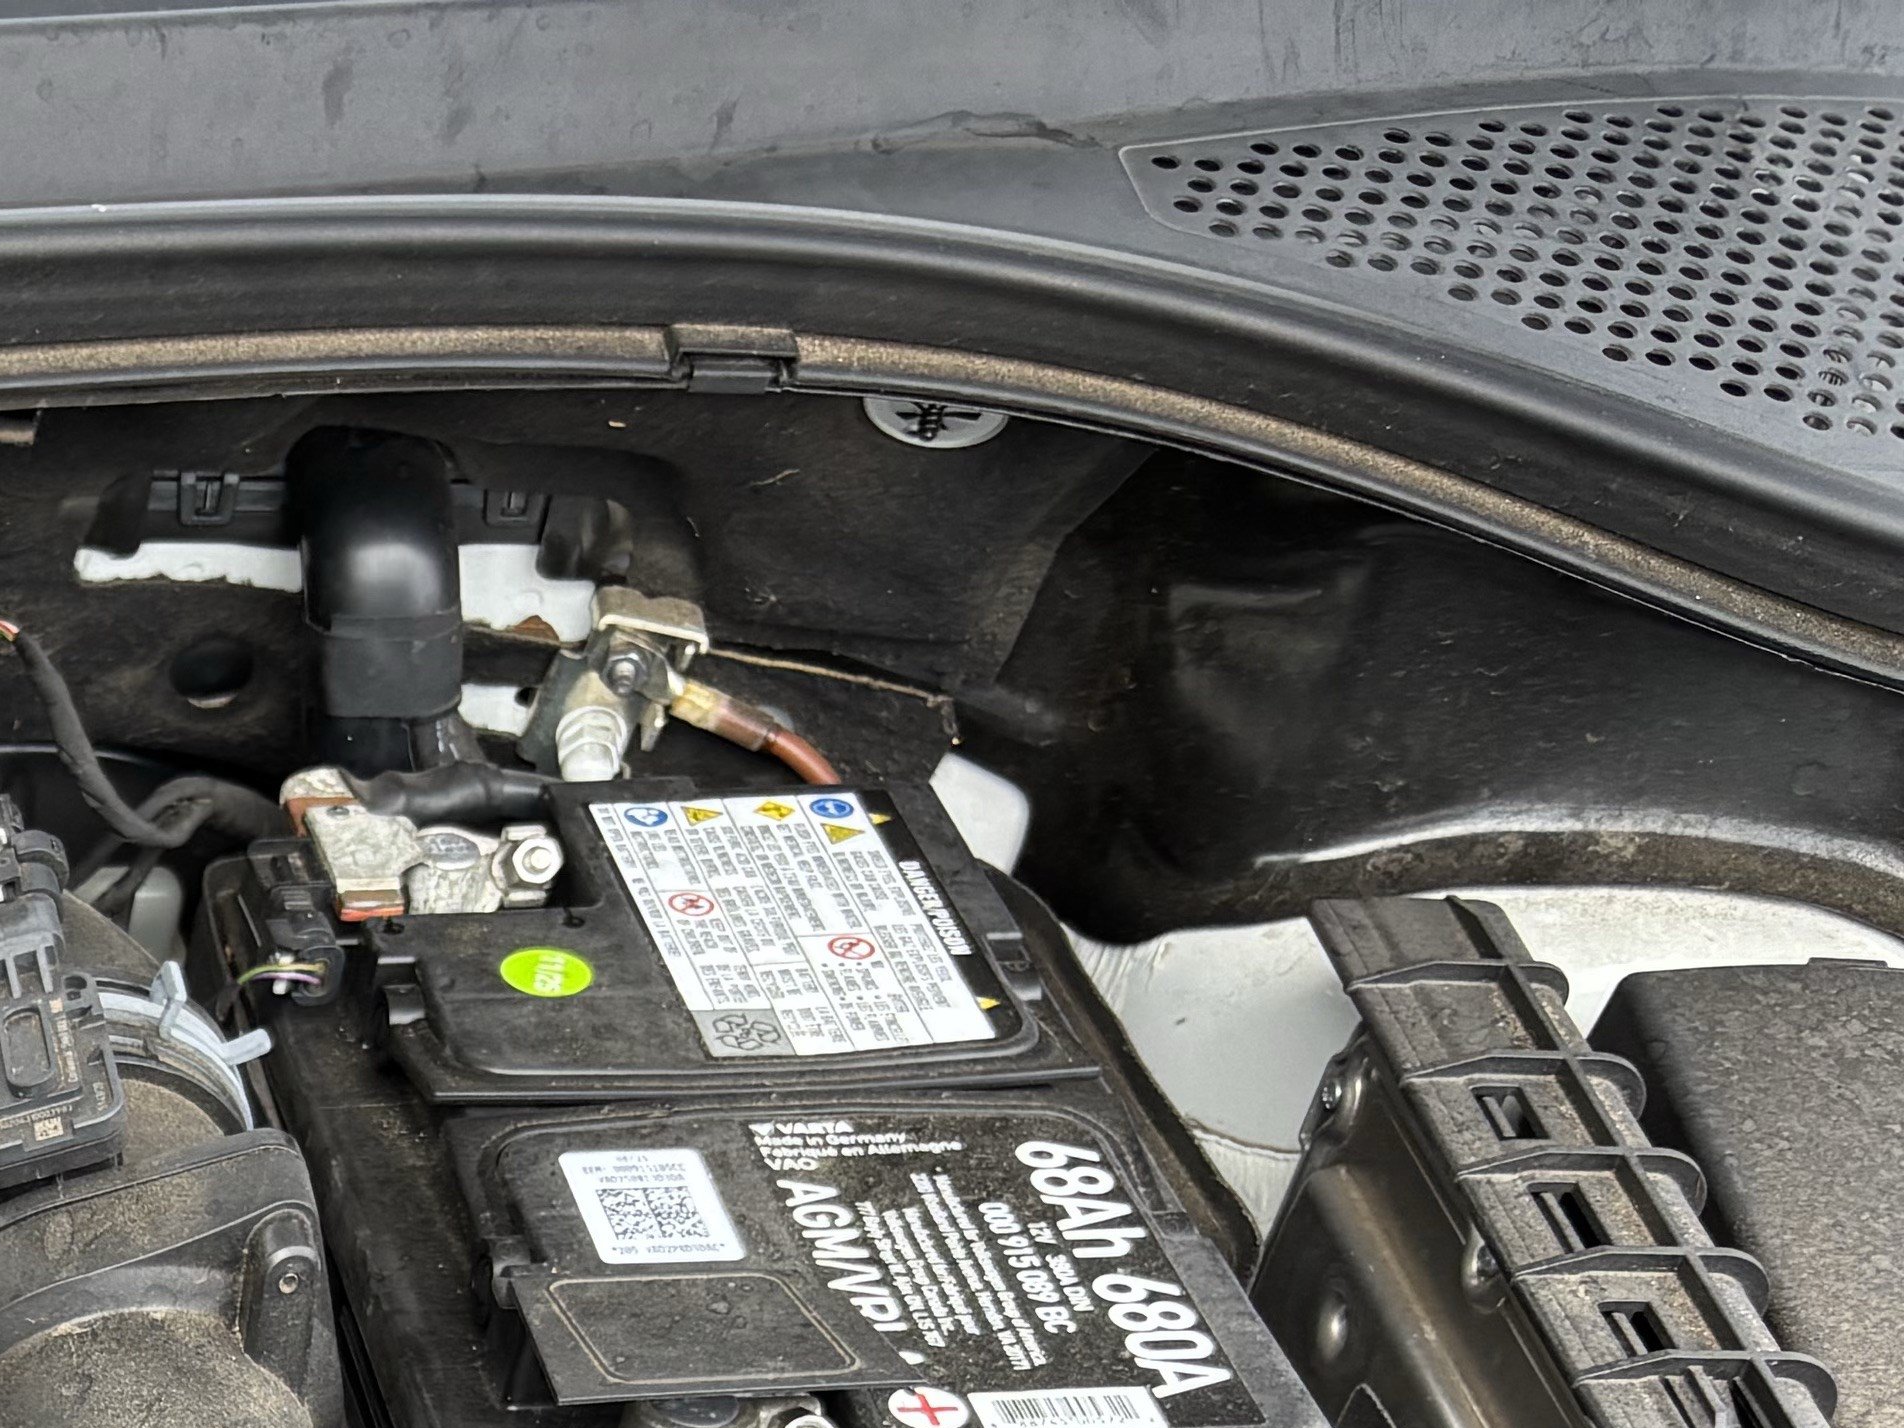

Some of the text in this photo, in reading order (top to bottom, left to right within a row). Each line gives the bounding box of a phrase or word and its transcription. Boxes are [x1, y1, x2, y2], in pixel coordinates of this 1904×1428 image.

[753, 1132, 906, 1145] Made in Germany
[776, 1120, 854, 1134] VARTA
[978, 1201, 1077, 1334] 000 915 089 BC
[1014, 1141, 1147, 1259] 68Ah
[1091, 1273, 1232, 1399] 680A
